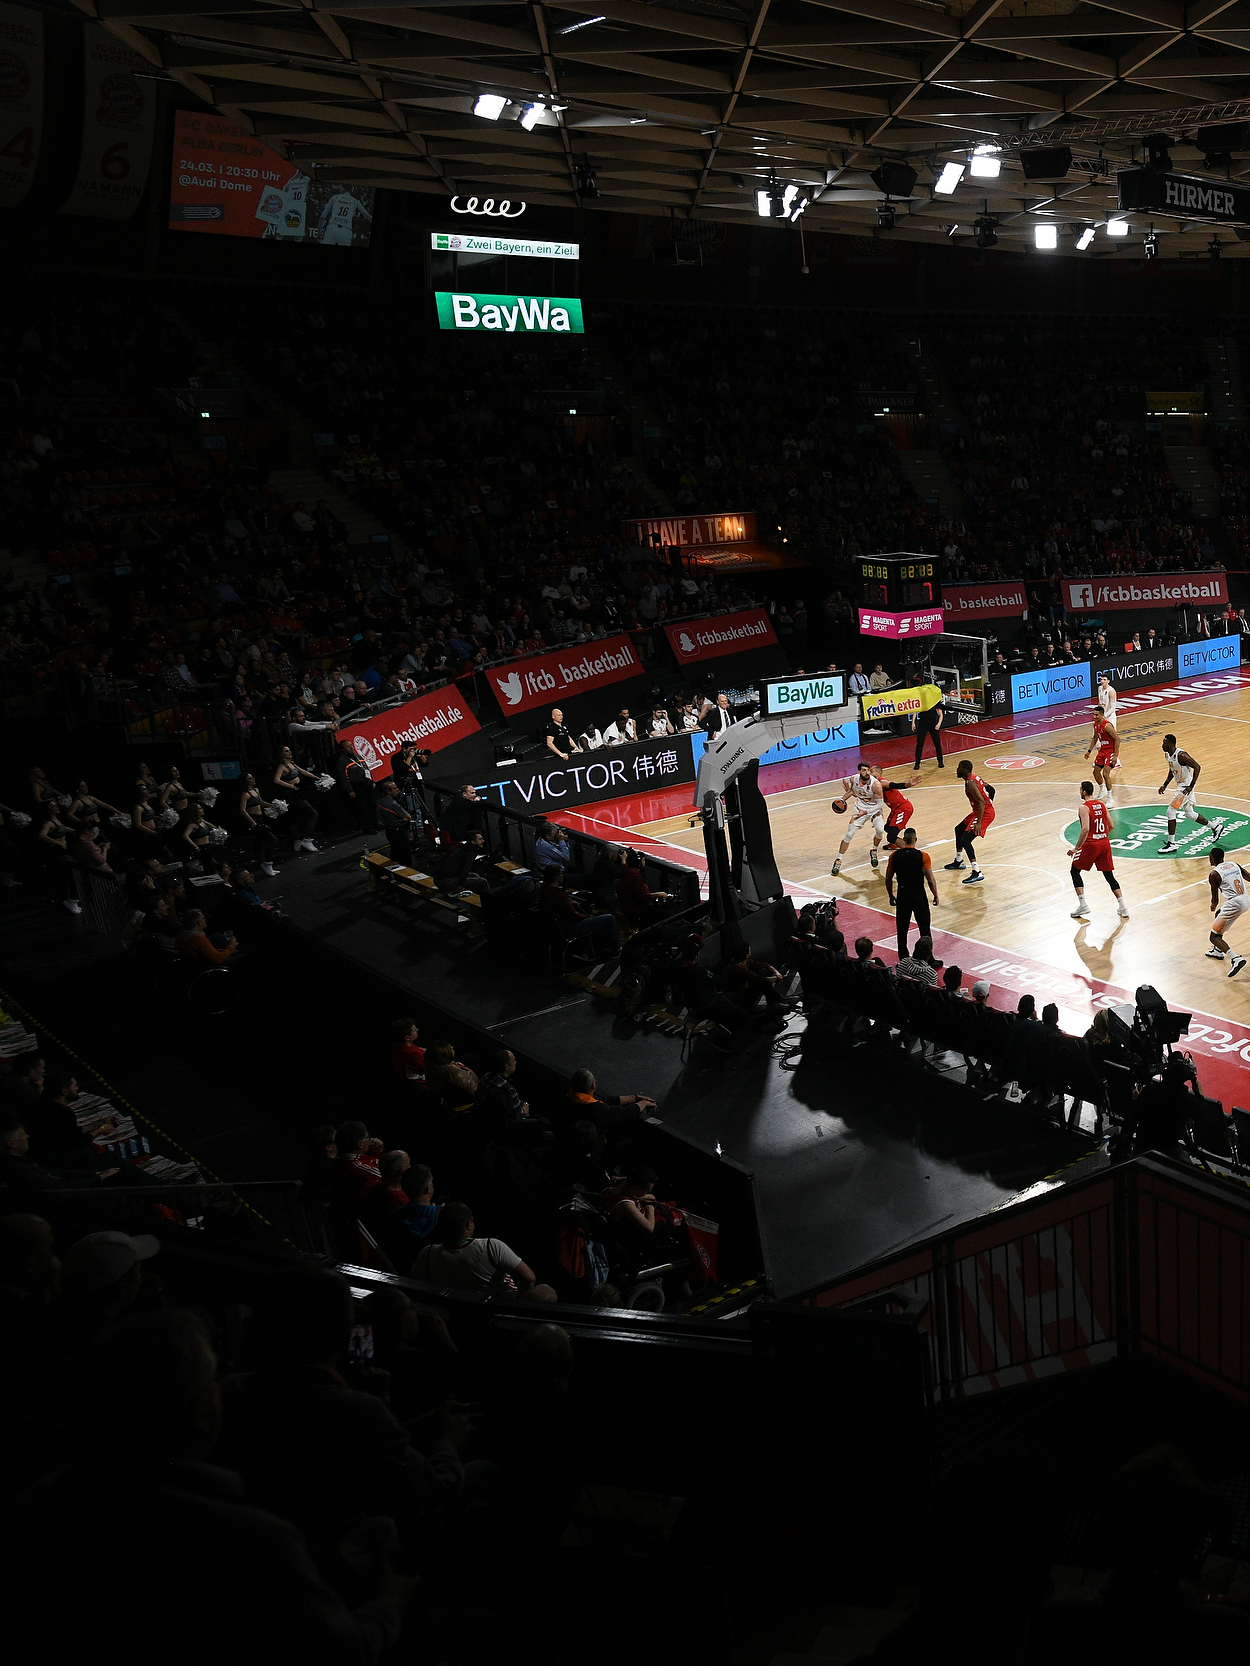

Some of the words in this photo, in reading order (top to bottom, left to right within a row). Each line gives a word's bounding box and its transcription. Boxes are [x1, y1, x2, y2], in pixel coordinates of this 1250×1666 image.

[180, 159, 216, 174] 24.03.
[226, 166, 259, 179] 20:30
[262, 170, 281, 182] Uhr
[179, 175, 217, 189] @Audi
[220, 181, 252, 192] Dome
[1165, 180, 1235, 216] HIRMER
[466, 238, 492, 250] Zwei
[495, 240, 534, 254] Bayern,
[536, 245, 552, 254] ein
[554, 246, 575, 256] Ziel.
[451, 294, 571, 332] BayWa
[692, 519, 703, 544] A
[704, 515, 747, 543] TEAM
[942, 593, 1023, 613] b_basketball
[1096, 580, 1221, 604] /fcbbasketball
[872, 615, 895, 627] MAGENTA
[873, 623, 888, 632] SPORT
[914, 613, 942, 624] MAGENTA
[914, 621, 933, 632] SPORT
[696, 620, 768, 646] fcbbasketball
[1183, 645, 1235, 667] BETVICTOR
[524, 645, 635, 697] /fcb_basketball
[777, 680, 834, 705] BayWa
[1018, 674, 1084, 700] BETVICTOR
[897, 698, 921, 712] extra
[632, 749, 679, 780] 伟德
[719, 746, 745, 774] SPALDING
[474, 759, 629, 807] TVICTOR
[1094, 817, 1106, 833] 16
[1233, 878, 1245, 895] 6
